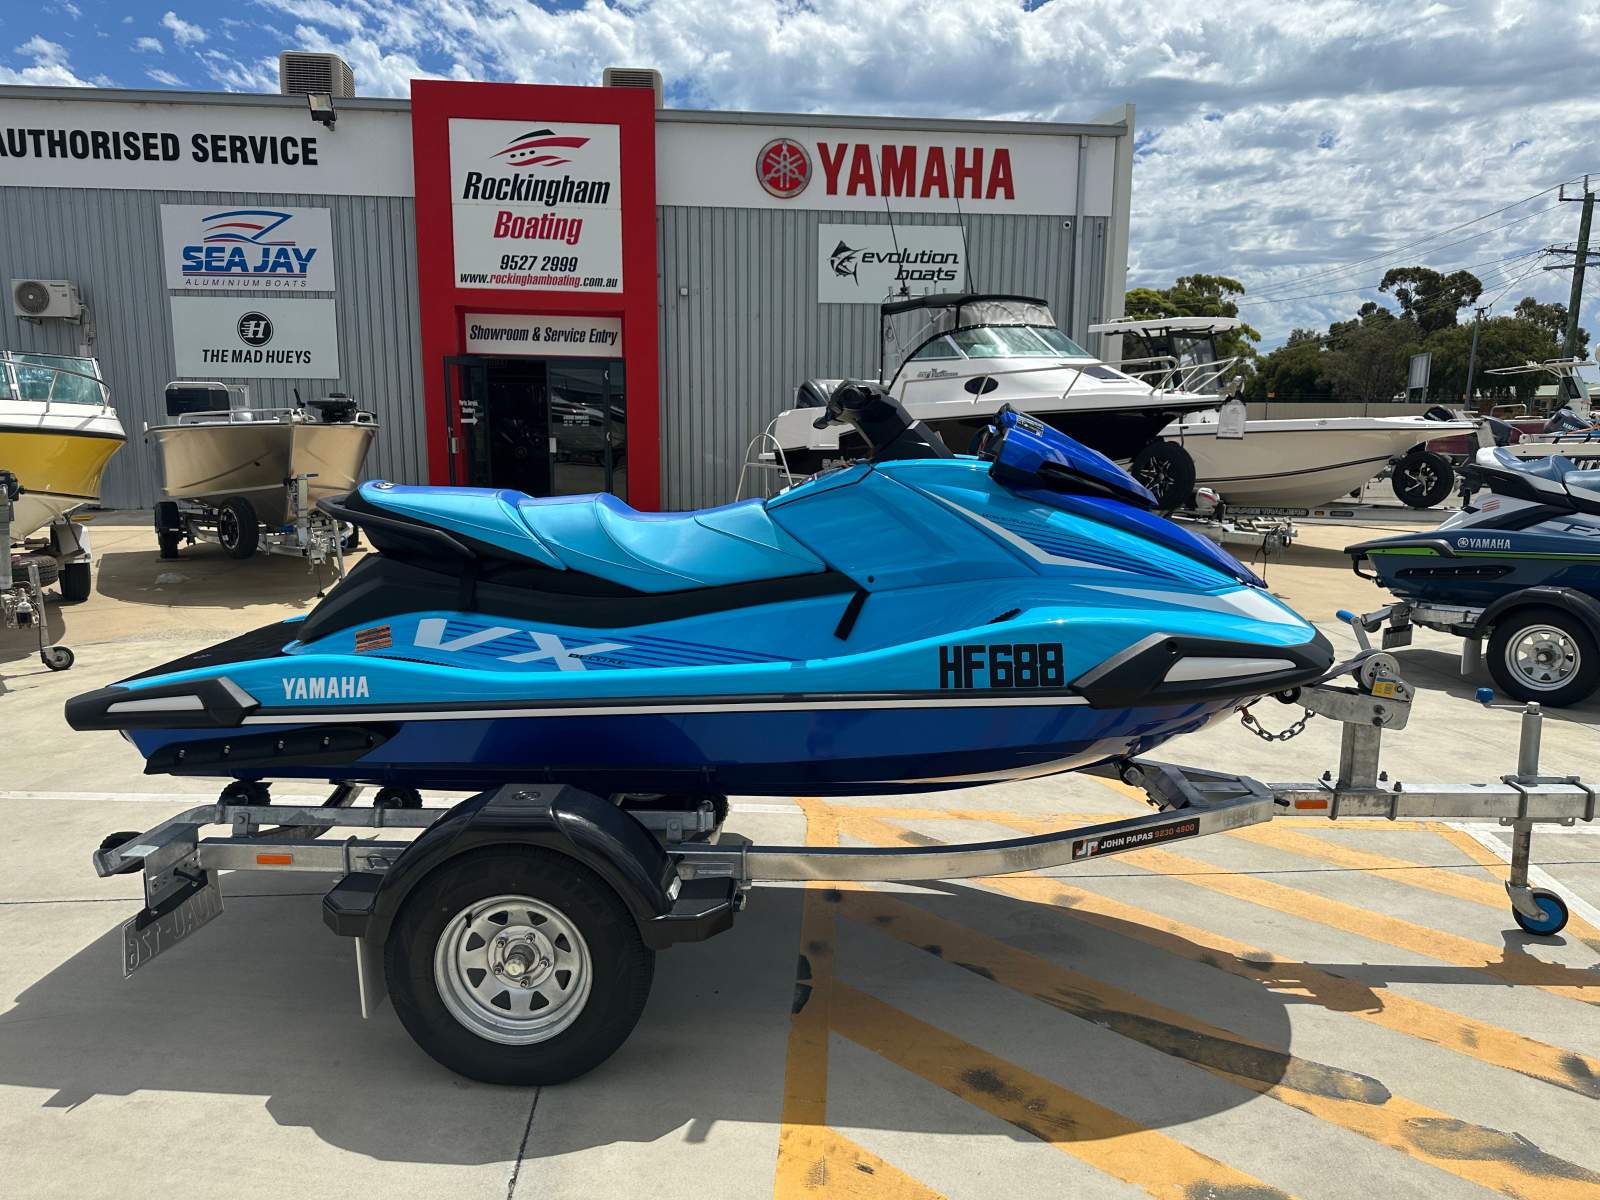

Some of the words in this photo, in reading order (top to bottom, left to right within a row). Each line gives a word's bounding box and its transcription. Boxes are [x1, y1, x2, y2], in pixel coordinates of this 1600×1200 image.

[191, 133, 318, 165] SERVICE
[816, 142, 1015, 200] YAMAHA
[462, 171, 611, 207] Rockingham
[493, 210, 583, 246] Boating
[182, 246, 250, 272] SEA
[253, 247, 317, 273] JAY
[500, 254, 537, 271] 9527
[541, 255, 578, 272] 2999
[861, 248, 959, 264] evolution
[185, 279, 260, 287] ALUMINIUM
[460, 272, 618, 288] www.rockinghamboating.com.au
[894, 265, 957, 281] boats
[469, 324, 529, 341] Showroom
[532, 327, 540, 342] &
[544, 327, 586, 343] Service
[589, 328, 618, 346] Entry
[202, 349, 229, 363] THE
[231, 350, 263, 363] MAD
[265, 350, 311, 364] HUEYS
[1469, 538, 1511, 549] YAMAHA
[413, 618, 633, 671] VX
[938, 642, 1065, 689] HF688
[282, 676, 370, 700] YAMAHA
[1100, 836, 1125, 849] JOHN
[1126, 831, 1154, 844] PAPAS
